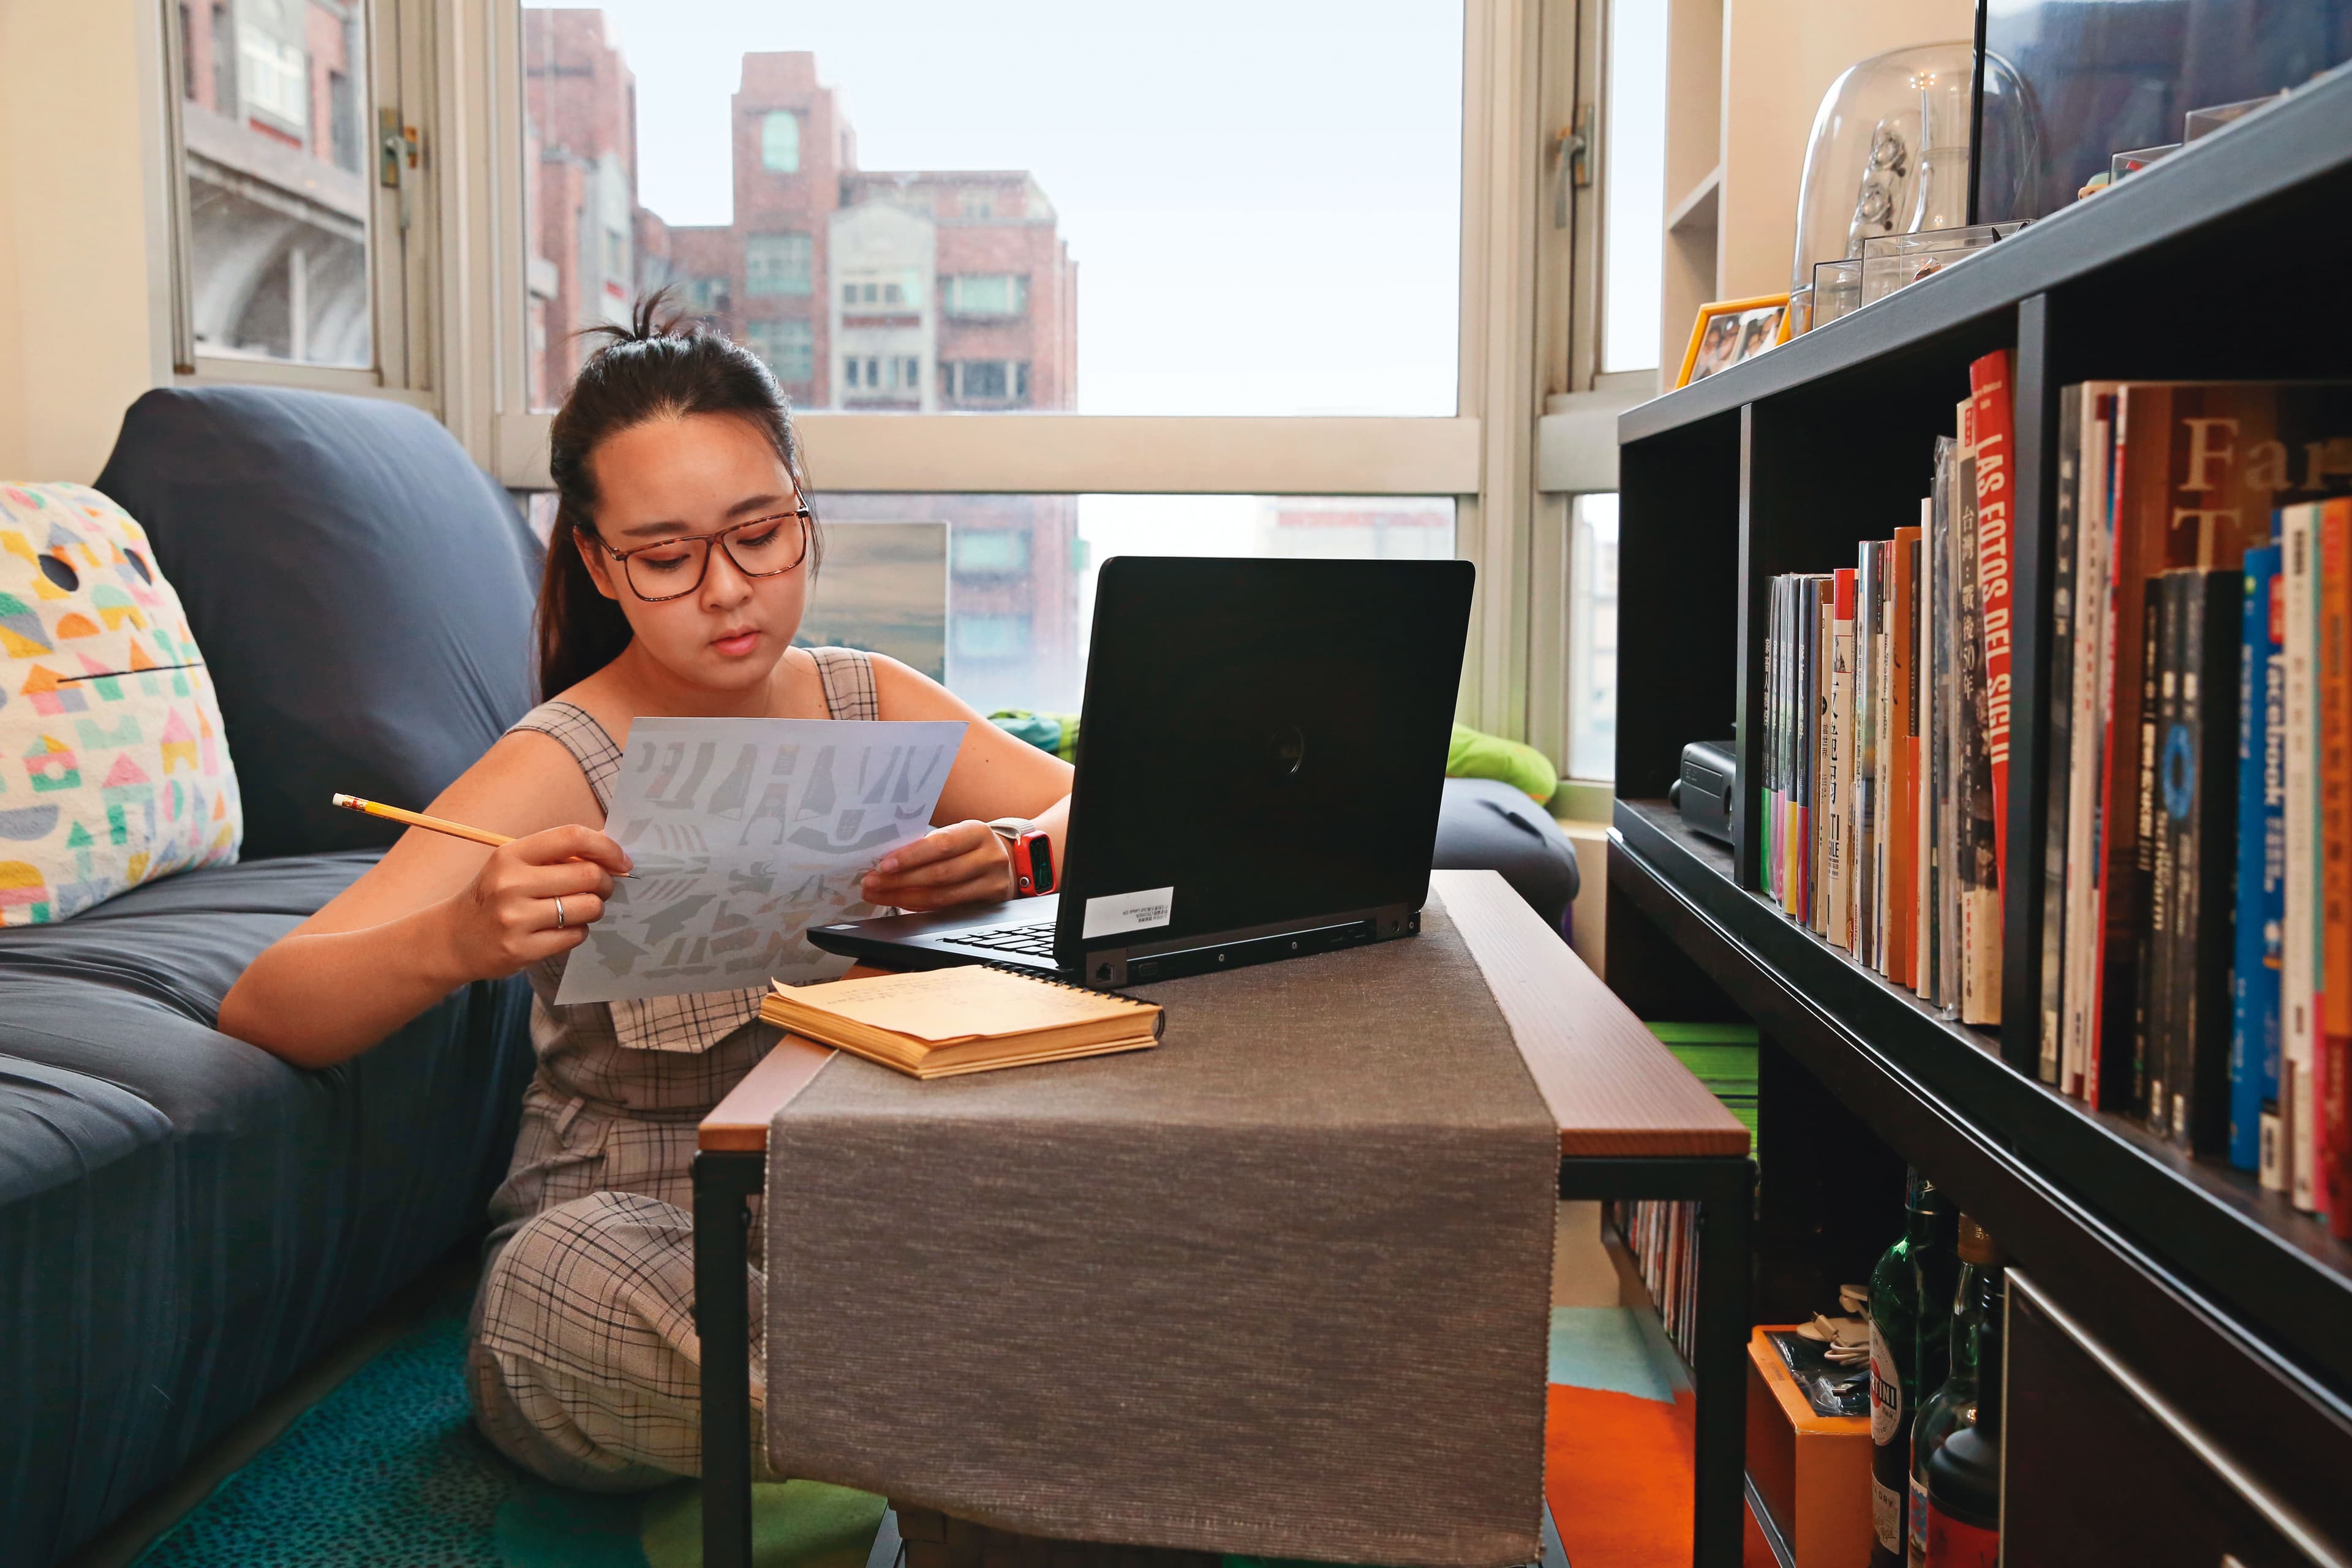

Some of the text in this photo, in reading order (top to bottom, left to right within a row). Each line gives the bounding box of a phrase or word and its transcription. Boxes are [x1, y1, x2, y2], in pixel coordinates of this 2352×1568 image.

[1975, 434, 2005, 497] LAS
[1979, 505, 2008, 602] FOTOS
[1984, 607, 2010, 658] DEL
[1830, 813, 1839, 841] TI
